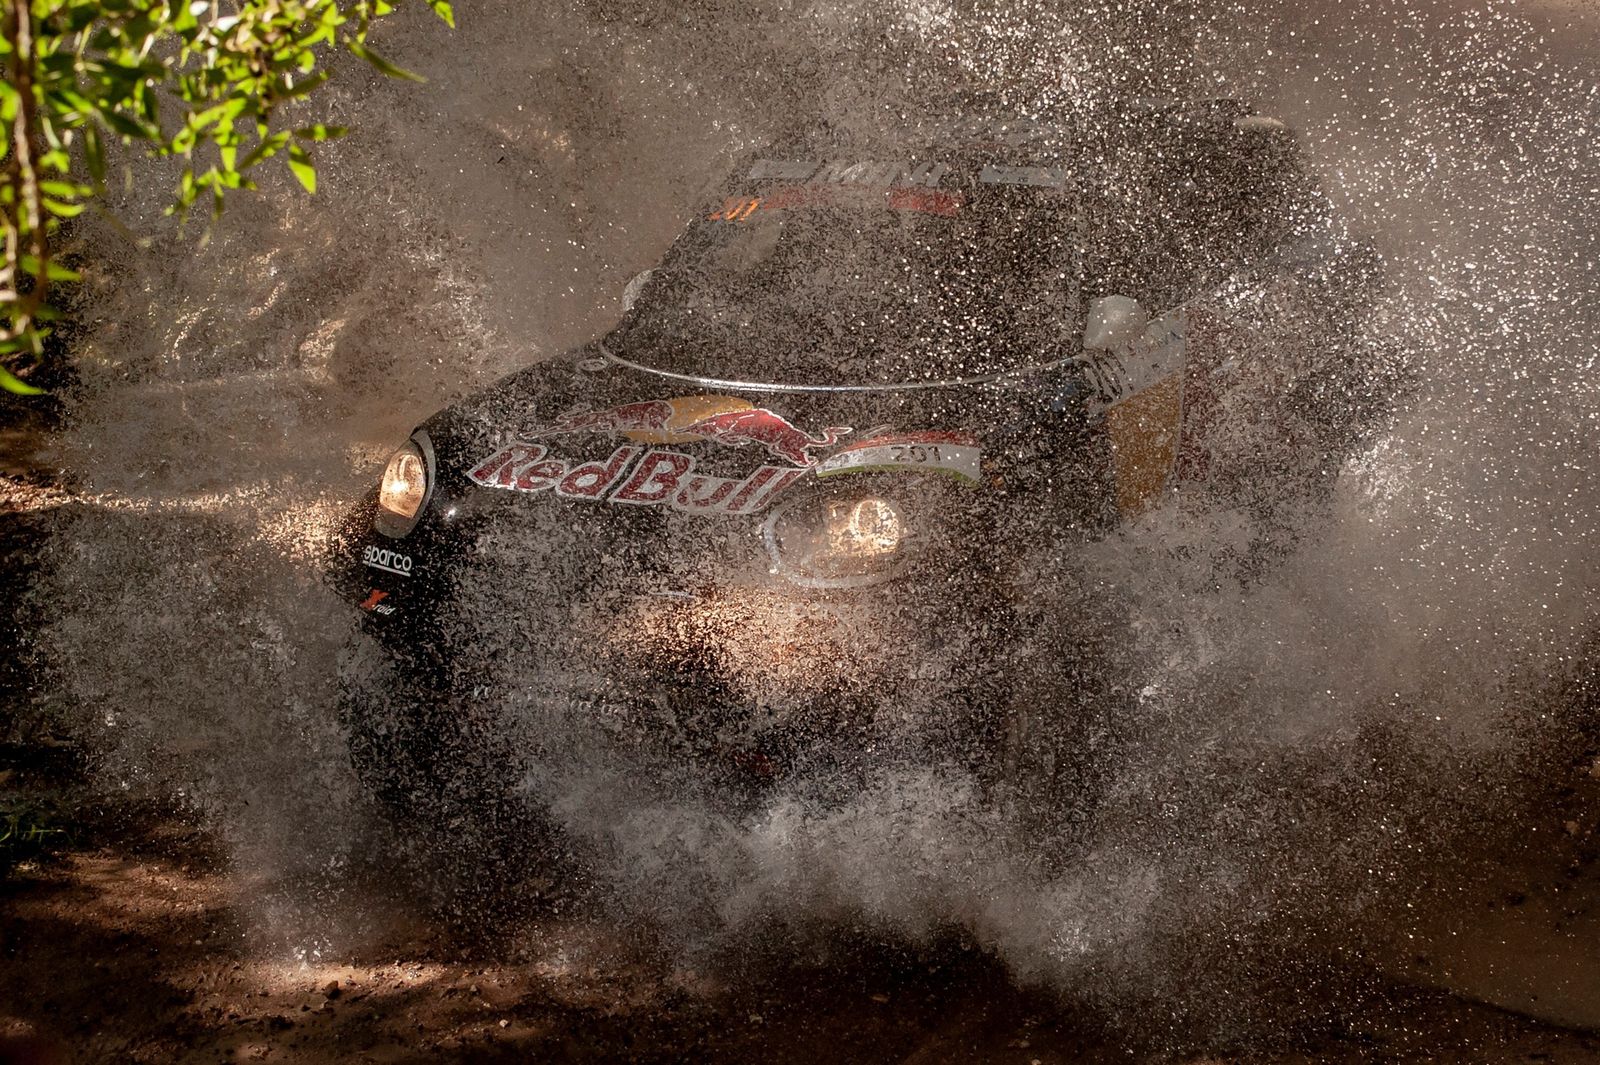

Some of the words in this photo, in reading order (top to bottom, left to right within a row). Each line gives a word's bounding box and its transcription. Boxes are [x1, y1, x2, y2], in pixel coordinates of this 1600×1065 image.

[466, 442, 643, 499] Red
[607, 449, 808, 514] Bull
[363, 545, 412, 571] sparco
